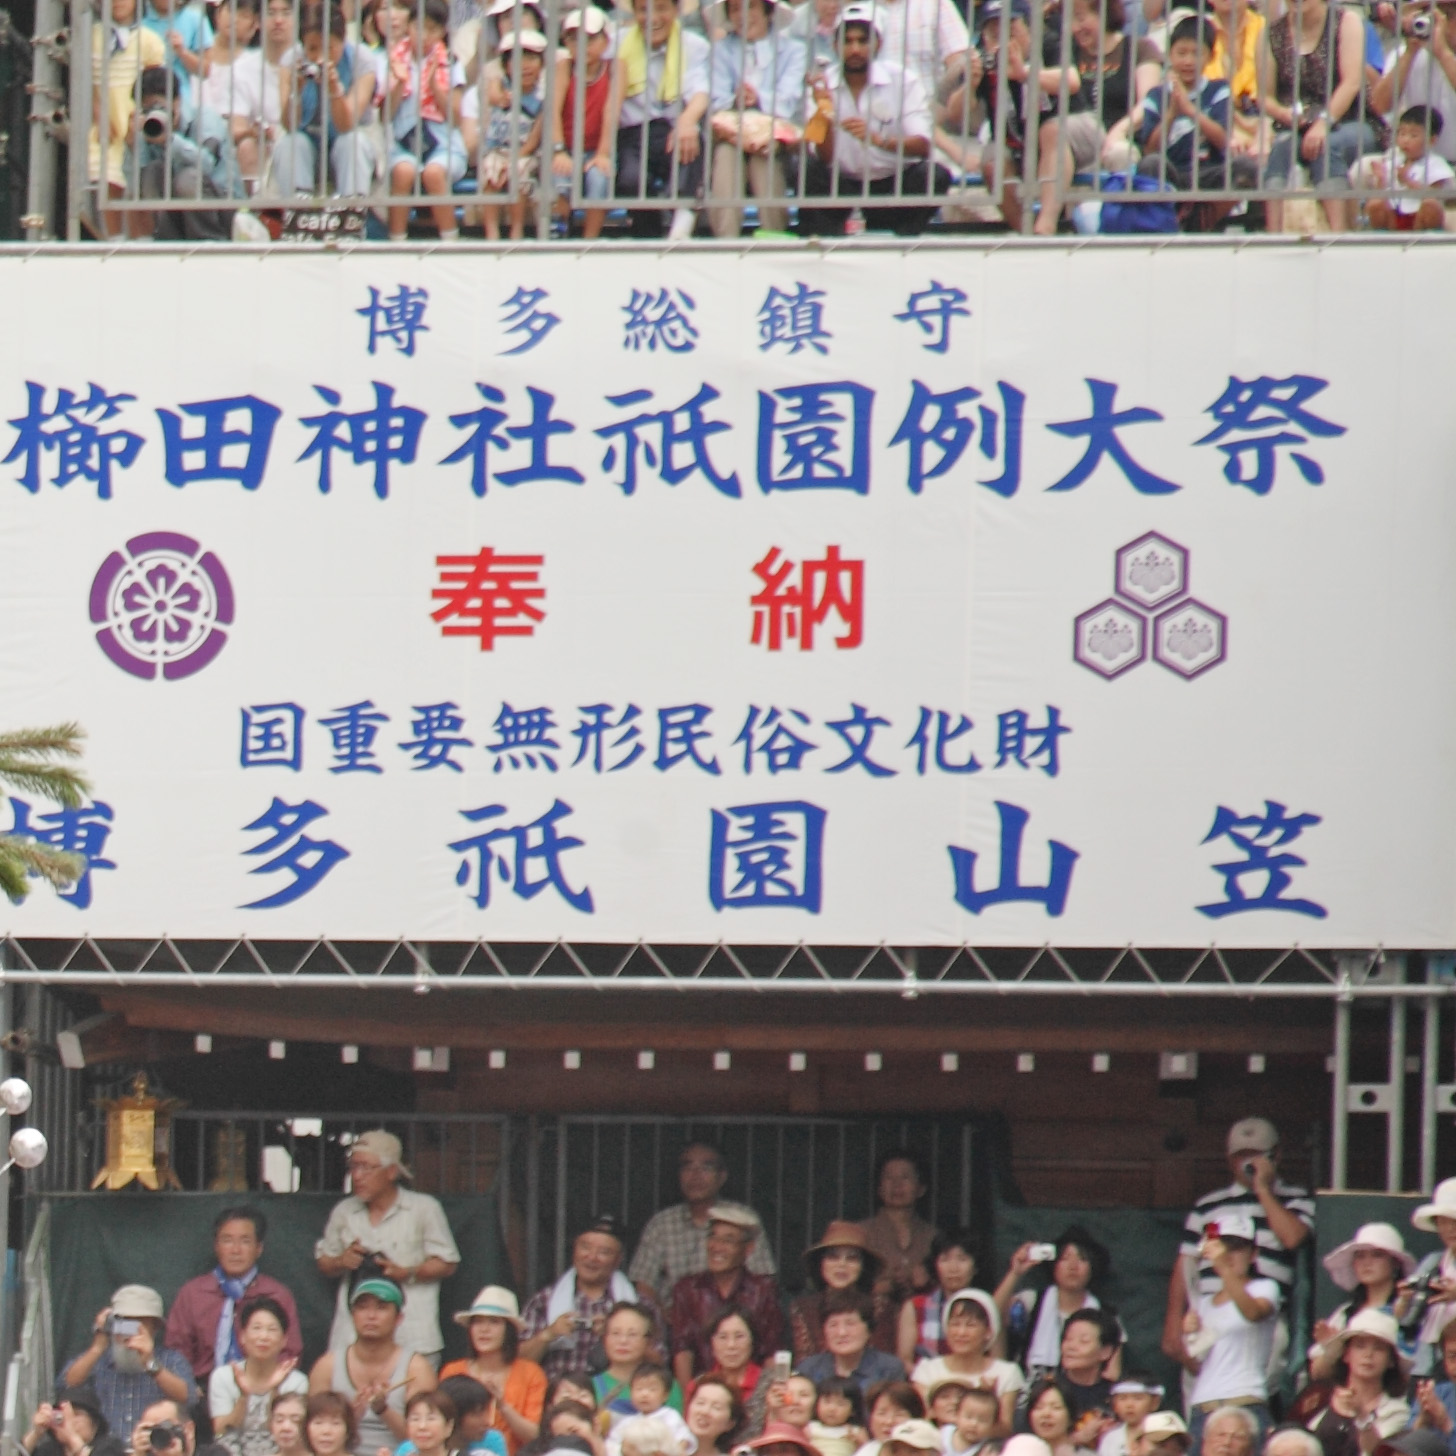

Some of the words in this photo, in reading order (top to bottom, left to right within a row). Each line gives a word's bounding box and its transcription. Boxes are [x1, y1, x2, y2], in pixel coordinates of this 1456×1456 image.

[356, 282, 968, 357] 博多総鎮守
[2, 374, 1346, 501] 櫛田神社祇園例大祭
[431, 545, 865, 651] 奉納
[239, 701, 1069, 778] 国重要無形民俗文化財
[6, 798, 1327, 918] 博多祇園山笠
